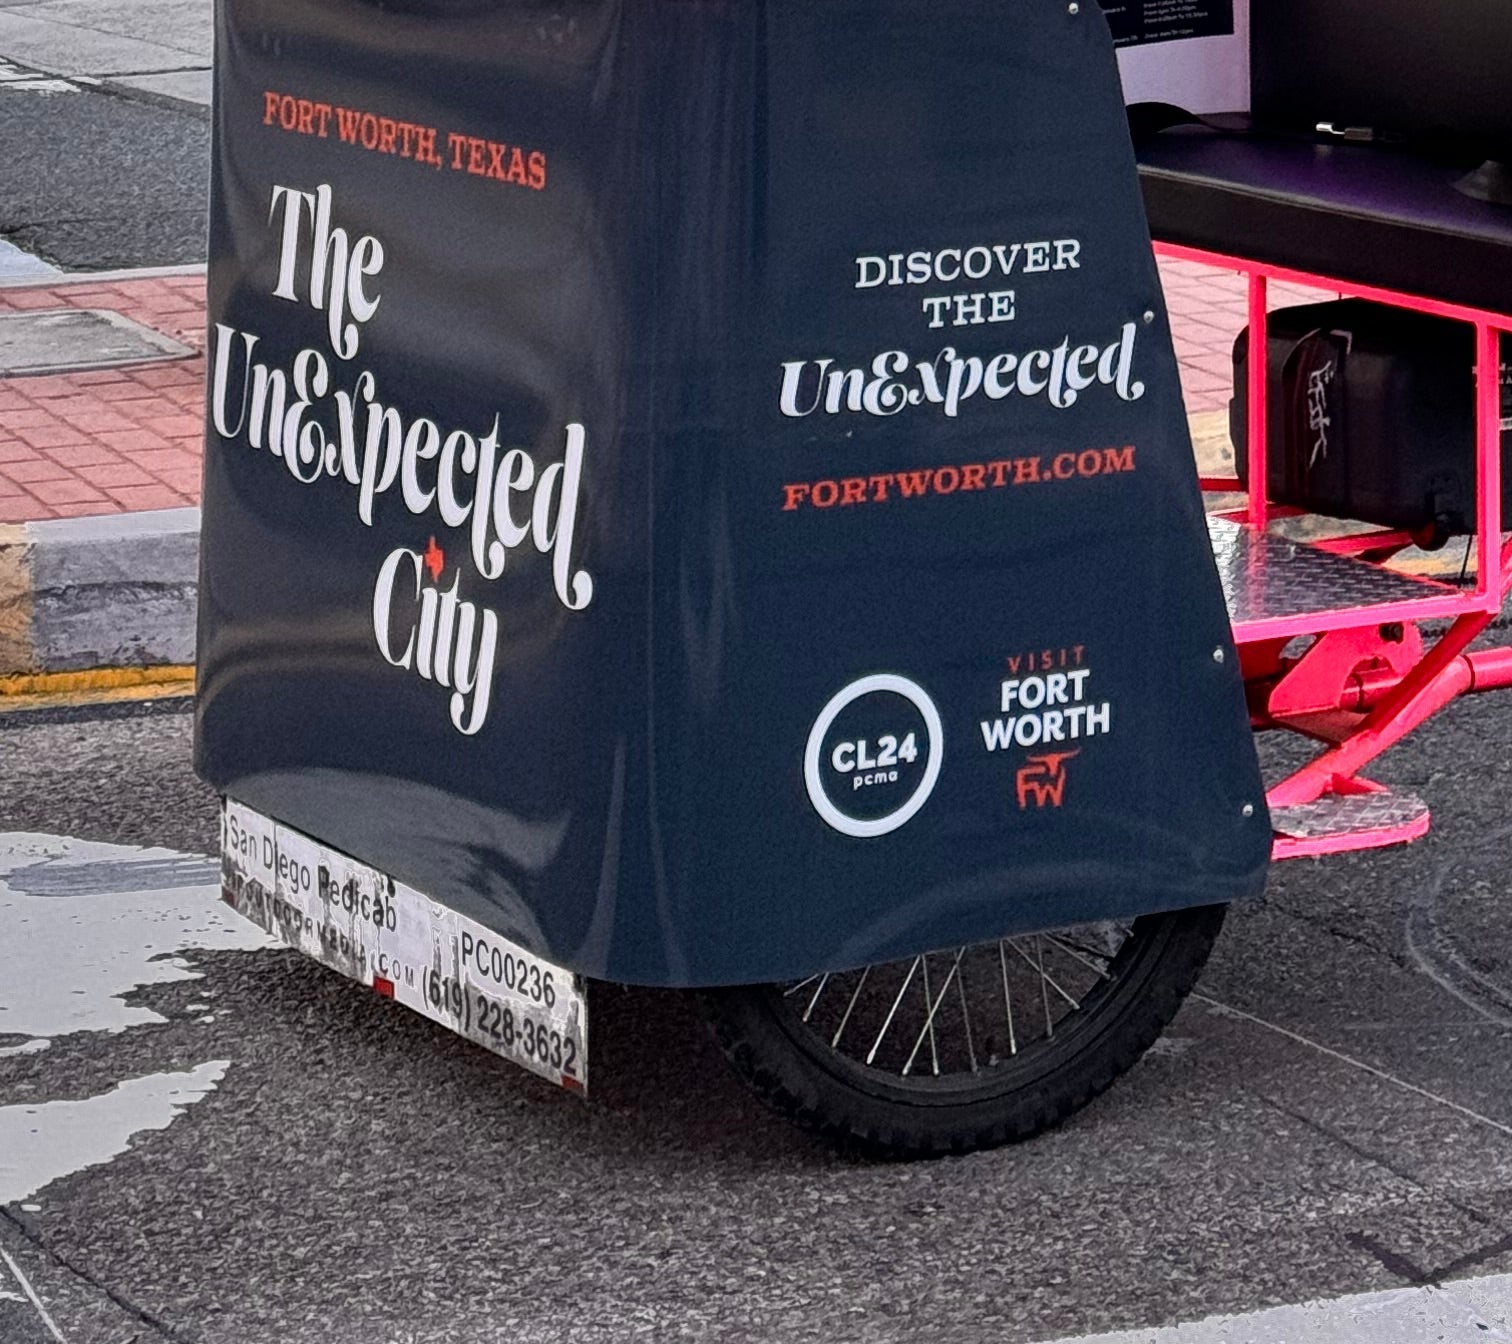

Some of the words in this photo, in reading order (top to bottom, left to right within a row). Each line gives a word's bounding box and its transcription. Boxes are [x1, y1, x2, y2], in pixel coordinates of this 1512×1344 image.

[263, 91, 332, 139] FORT
[336, 108, 442, 170] WORTH,
[448, 133, 547, 190] TEXAS
[268, 184, 385, 360] The
[855, 238, 1081, 289] DISCOVER
[922, 290, 1016, 329] THE
[782, 446, 1136, 511] FORTWORTH.COM
[373, 538, 498, 735] City
[1007, 644, 1085, 674] VISIT
[1000, 668, 1091, 712] FORT
[831, 732, 918, 773] CL24
[980, 702, 1111, 752] WORTH
[853, 770, 898, 791] pcma
[230, 815, 257, 860] San
[263, 835, 311, 894] Diego
[317, 865, 397, 932] Pedicab
[462, 931, 556, 1009] PC00236
[422, 965, 471, 1033] (619)
[477, 995, 577, 1077] 228-3632
